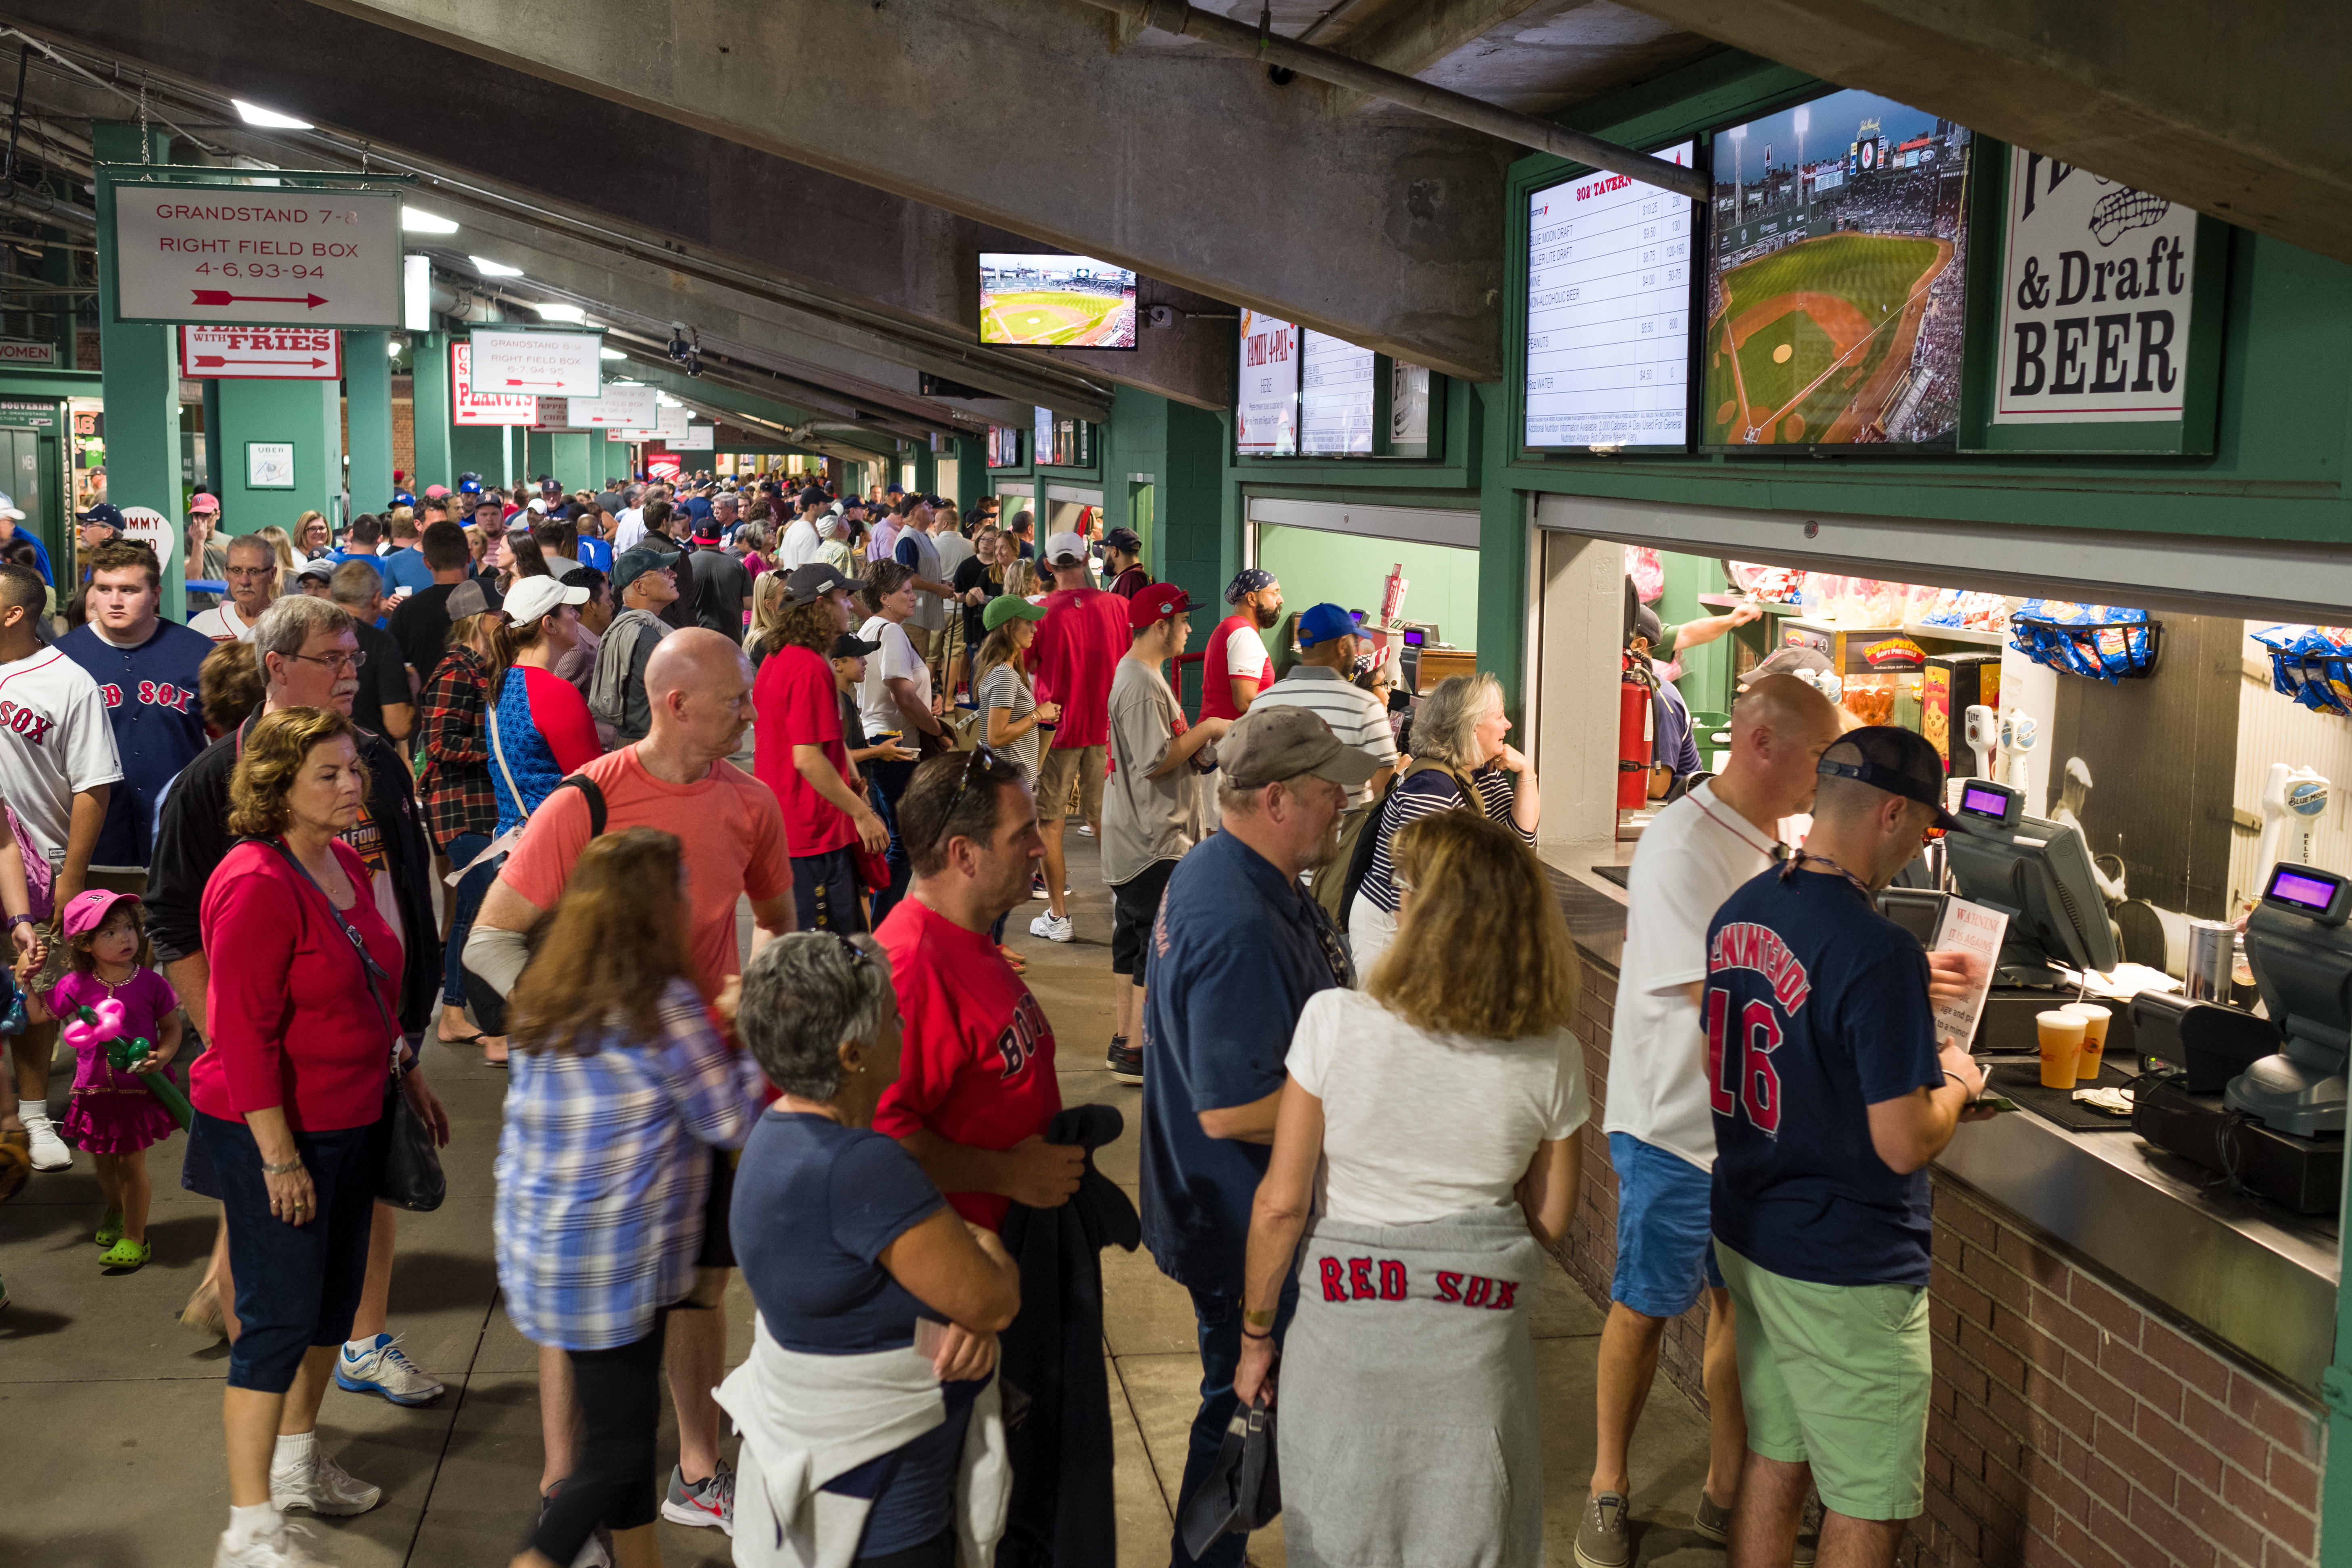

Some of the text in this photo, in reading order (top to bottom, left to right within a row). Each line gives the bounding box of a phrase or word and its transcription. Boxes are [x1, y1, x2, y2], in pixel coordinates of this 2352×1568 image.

[1577, 175, 1632, 201] 302' TAVERN
[1643, 195, 1681, 216] $10.25 230
[157, 204, 358, 225] GRANDSTAND 7-8
[1530, 225, 1573, 247] BLUE MOON DRAFT
[1644, 220, 1680, 239] $9.50 130
[160, 237, 358, 257] RIGHT FIELD BOX
[1546, 251, 1556, 263] LITE
[1557, 247, 1572, 261] DRAFT
[1643, 243, 1685, 263] $8.75 120-160
[248, 263, 324, 279] 93-94
[1643, 268, 1682, 286] $4.00 50-75
[2018, 236, 2184, 310] & Draft
[1567, 288, 1580, 301] BEER
[1641, 321, 1654, 333] $5.50
[194, 334, 330, 351] WITH FRIES
[490, 339, 582, 350] GRANDSTAND 8-9
[1248, 333, 1267, 367] FAMILY
[1528, 336, 1549, 349] PEANUTS
[491, 354, 523, 363] RIGHT
[527, 356, 556, 364] FIELD
[2010, 310, 2177, 396] BEER
[530, 367, 564, 375] 94-95
[1640, 366, 1674, 381] $4.50 0
[1261, 378, 1271, 393] HERE
[1537, 377, 1554, 389] WATER
[1, 402, 54, 411] SOUVENIRS
[1633, 420, 1641, 432] Day
[1642, 419, 1654, 430] Used
[1876, 648, 1917, 658] SOFT PRETZELS
[0, 701, 53, 745] SOX
[1967, 711, 1979, 722] Lite
[2017, 732, 2030, 741] BLUE
[2289, 790, 2327, 806] BLUE MOON
[1949, 929, 1994, 952] IT IS AGAINS
[1953, 1007, 1965, 1020] and
[1965, 1013, 1974, 1023] pa
[1937, 1019, 1944, 1028] to
[1950, 1023, 1969, 1039] minor
[1319, 1256, 1518, 1310] RED SOX
